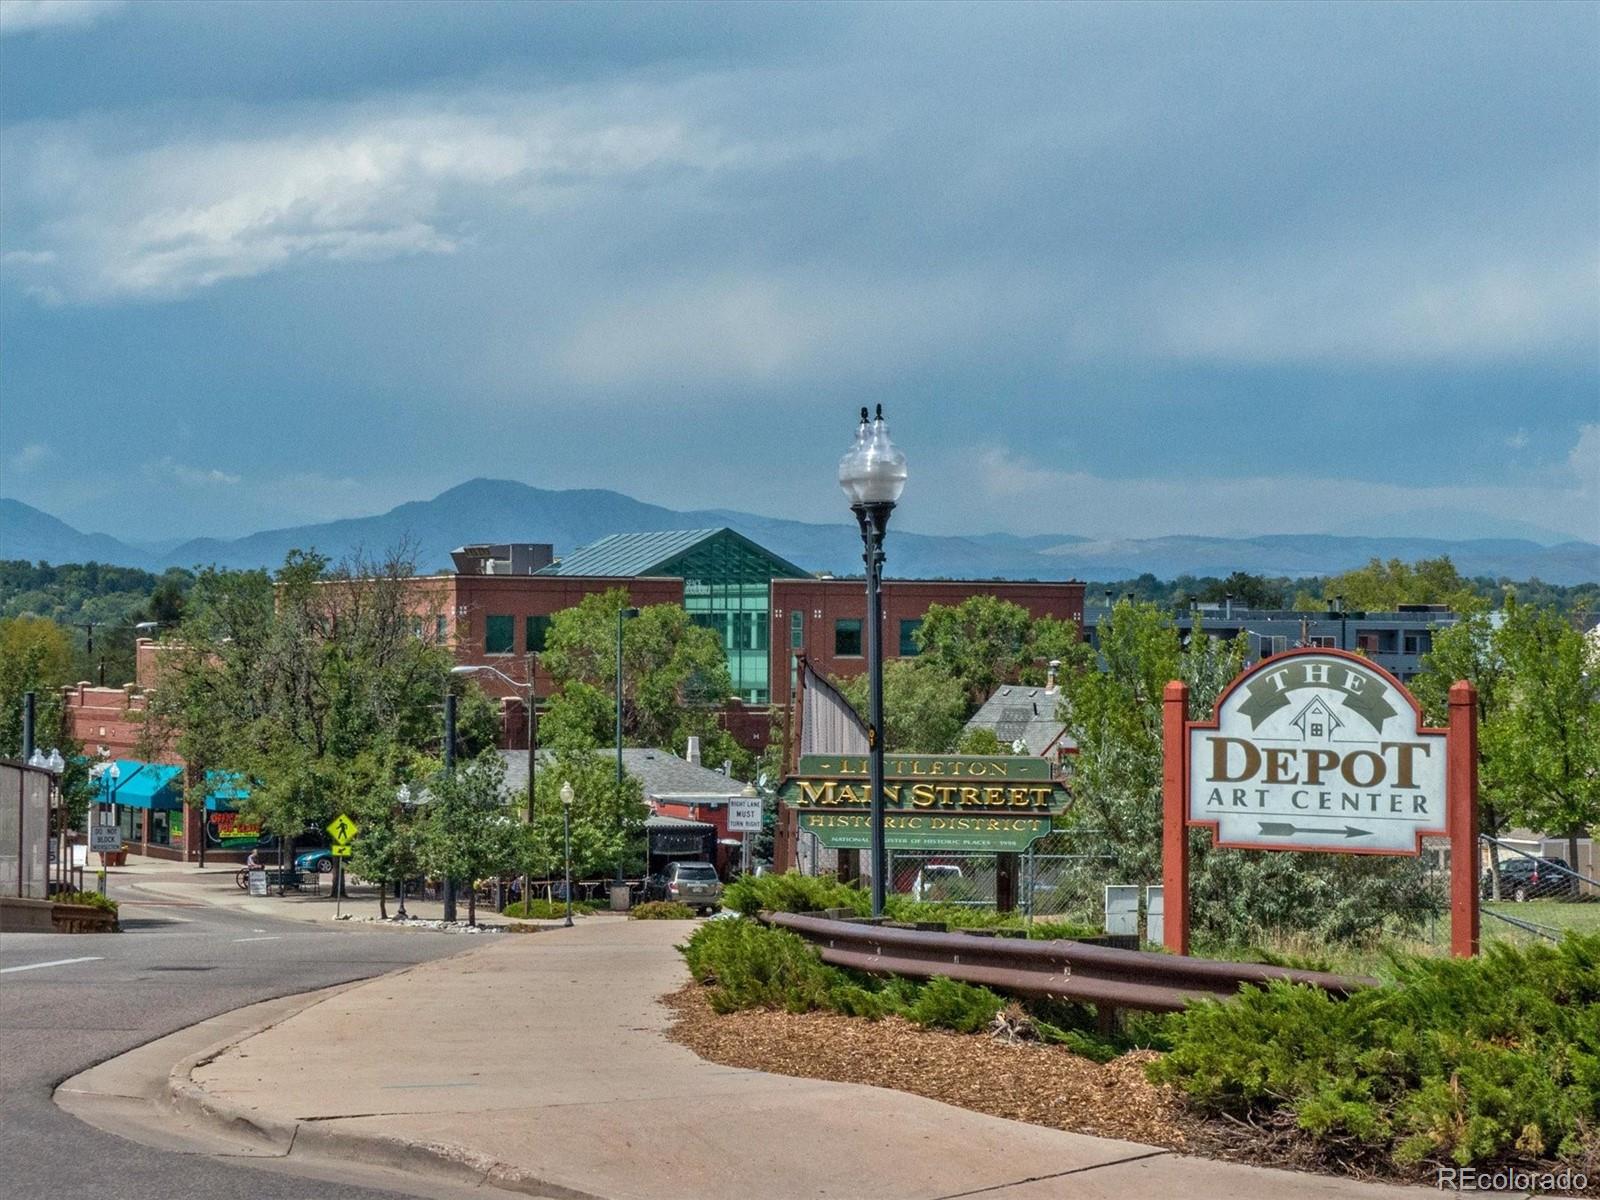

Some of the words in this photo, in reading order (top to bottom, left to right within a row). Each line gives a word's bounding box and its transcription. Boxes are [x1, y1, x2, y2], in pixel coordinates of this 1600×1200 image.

[1266, 664, 1367, 695] THE
[1206, 737, 1430, 789] DEPOT
[912, 783, 1051, 807] STREET
[1207, 788, 1270, 808] ART
[1291, 790, 1429, 814] CENTER
[930, 817, 1042, 831] DISTRICT
